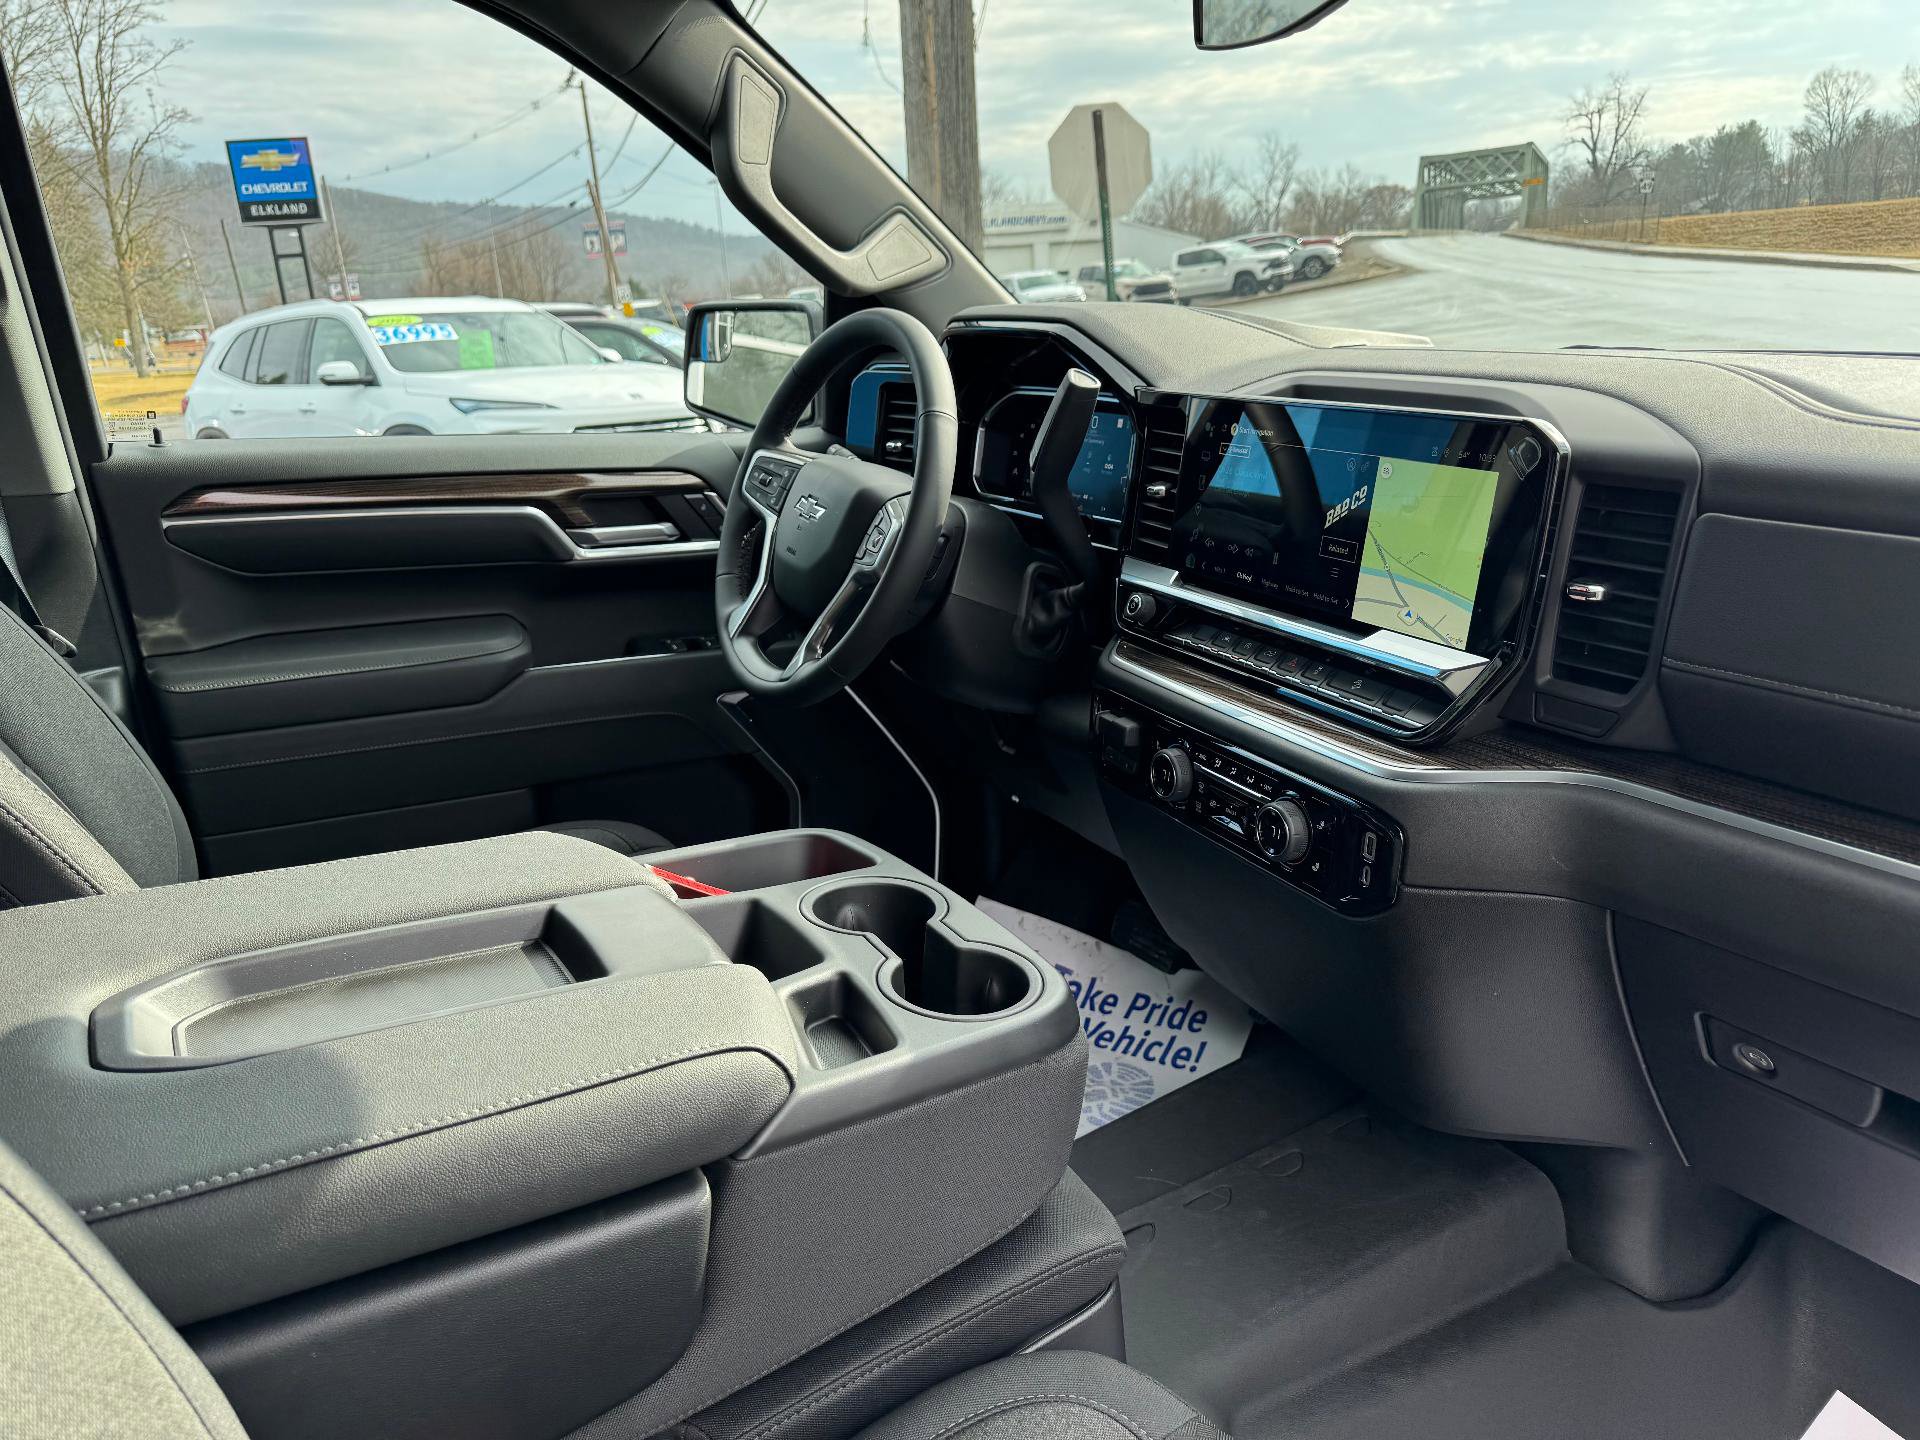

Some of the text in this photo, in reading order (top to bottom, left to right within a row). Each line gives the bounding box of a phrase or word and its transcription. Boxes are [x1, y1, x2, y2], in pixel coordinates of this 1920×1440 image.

[241, 182, 308, 195] CHEVROLET
[250, 203, 308, 216] ELKLAND
[375, 323, 452, 345] 36995
[1124, 992, 1208, 1033] Pride
[1083, 1017, 1208, 1073] Vehicle!
